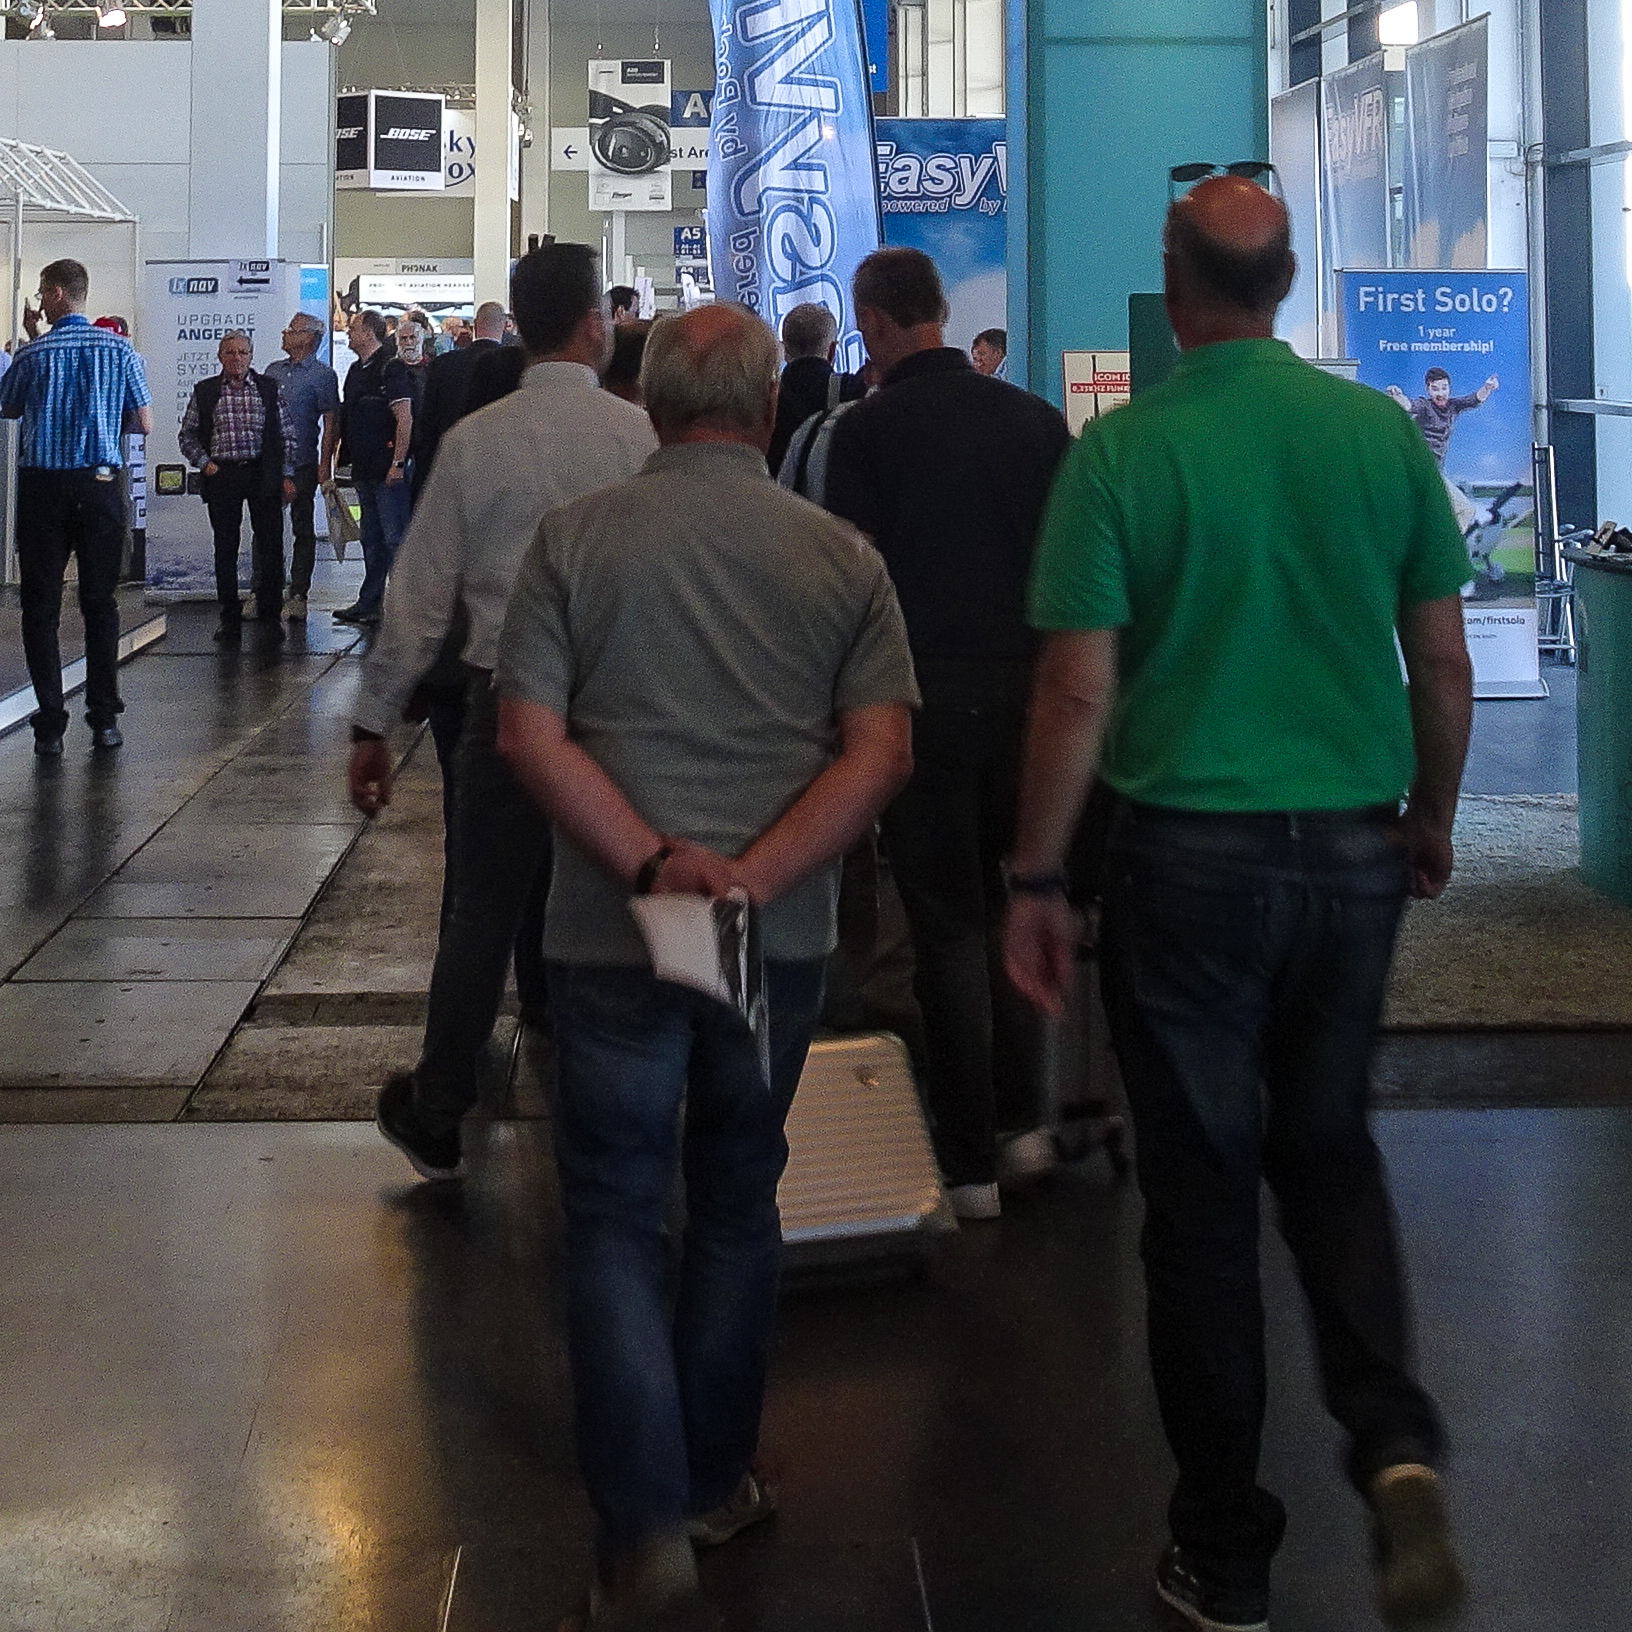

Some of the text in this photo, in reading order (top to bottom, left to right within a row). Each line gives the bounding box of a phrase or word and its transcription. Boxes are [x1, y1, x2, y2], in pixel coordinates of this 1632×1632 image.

[682, 92, 715, 118] A
[336, 127, 363, 139] OSE
[379, 127, 437, 141] BOSE
[979, 197, 1000, 216] by
[680, 227, 701, 240] A5
[1358, 285, 1514, 314] First Solo?
[176, 314, 256, 326] UPGRADE
[176, 328, 257, 341] ANGET
[1418, 325, 1457, 340] 1 year
[1379, 340, 1409, 352] Free
